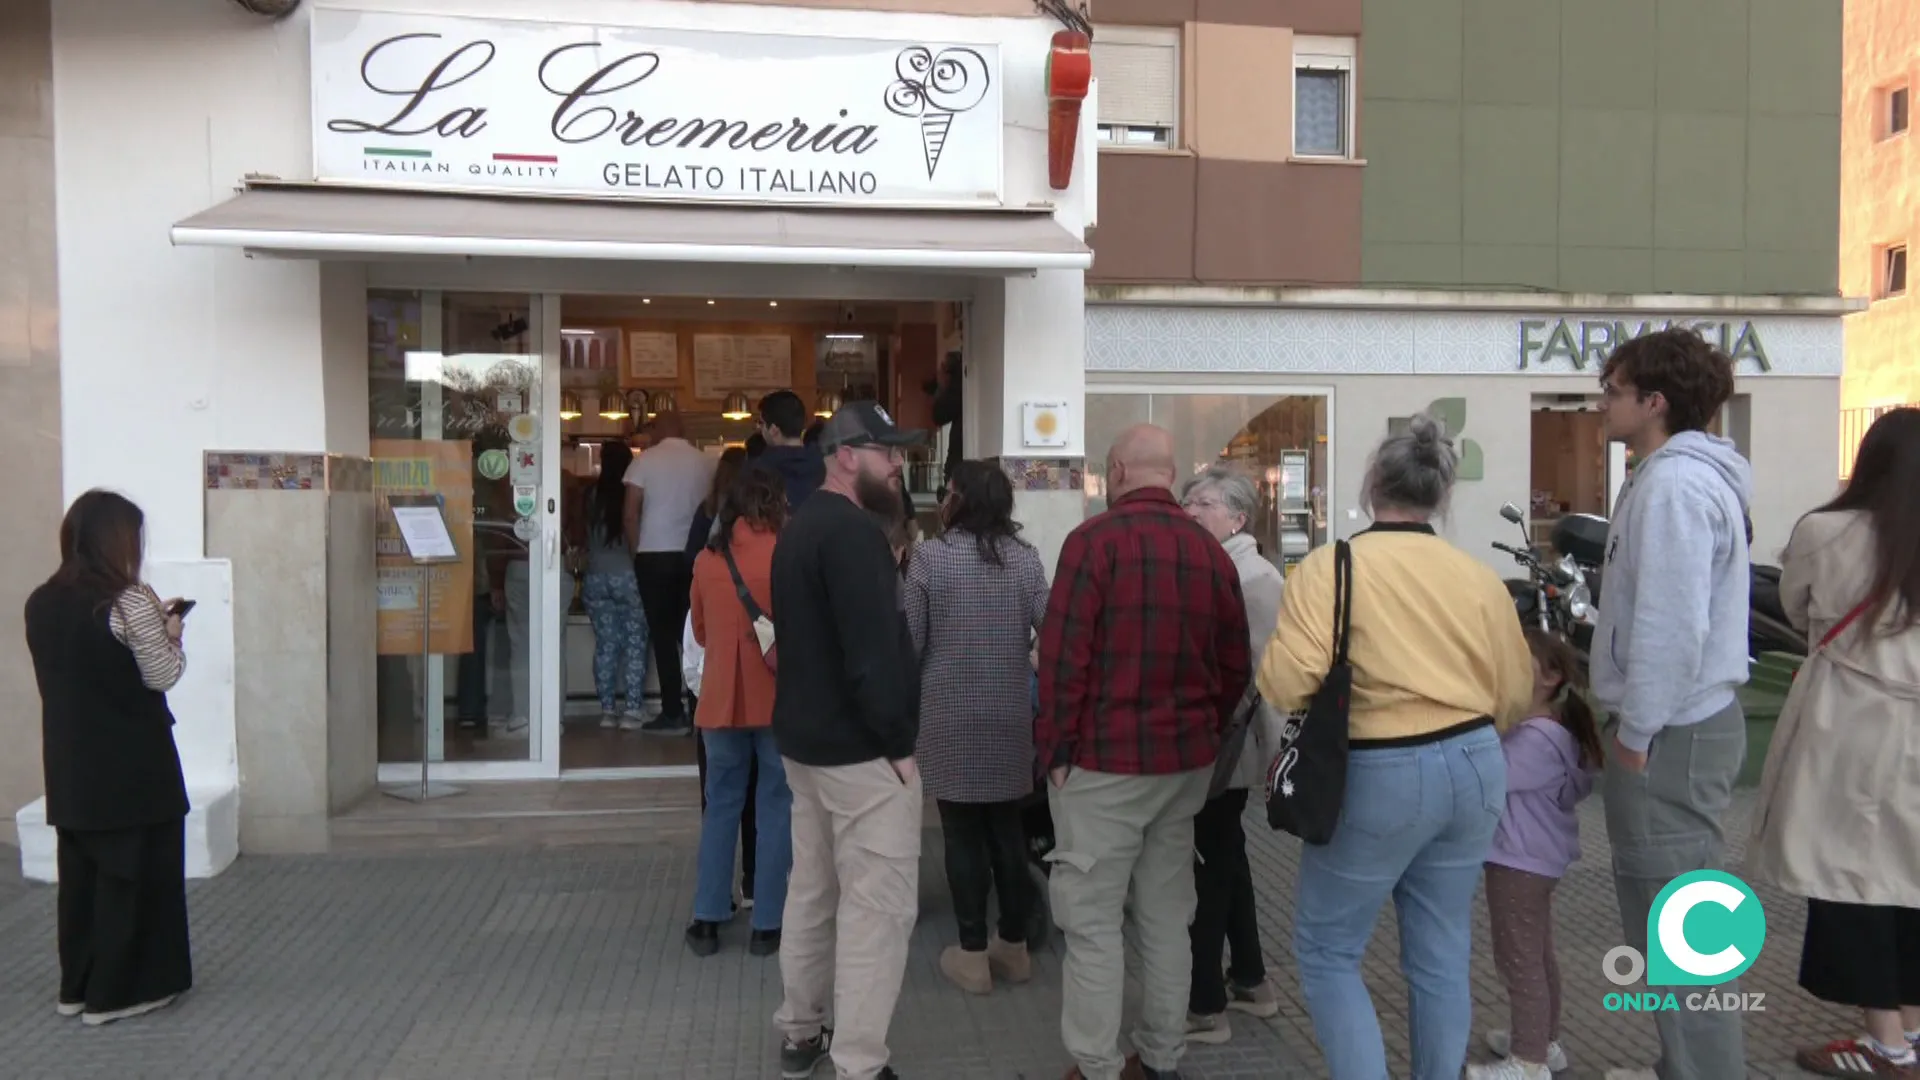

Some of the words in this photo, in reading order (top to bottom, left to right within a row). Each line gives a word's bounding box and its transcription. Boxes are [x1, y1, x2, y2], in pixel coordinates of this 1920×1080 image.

[327, 33, 496, 138] La
[538, 42, 878, 154] Cremeria
[363, 160, 449, 174] ITALIAN
[468, 164, 559, 178] QUALITY
[603, 163, 724, 190] GELATO
[740, 168, 877, 195] ITALIANO
[1519, 316, 1772, 372] FARMIA
